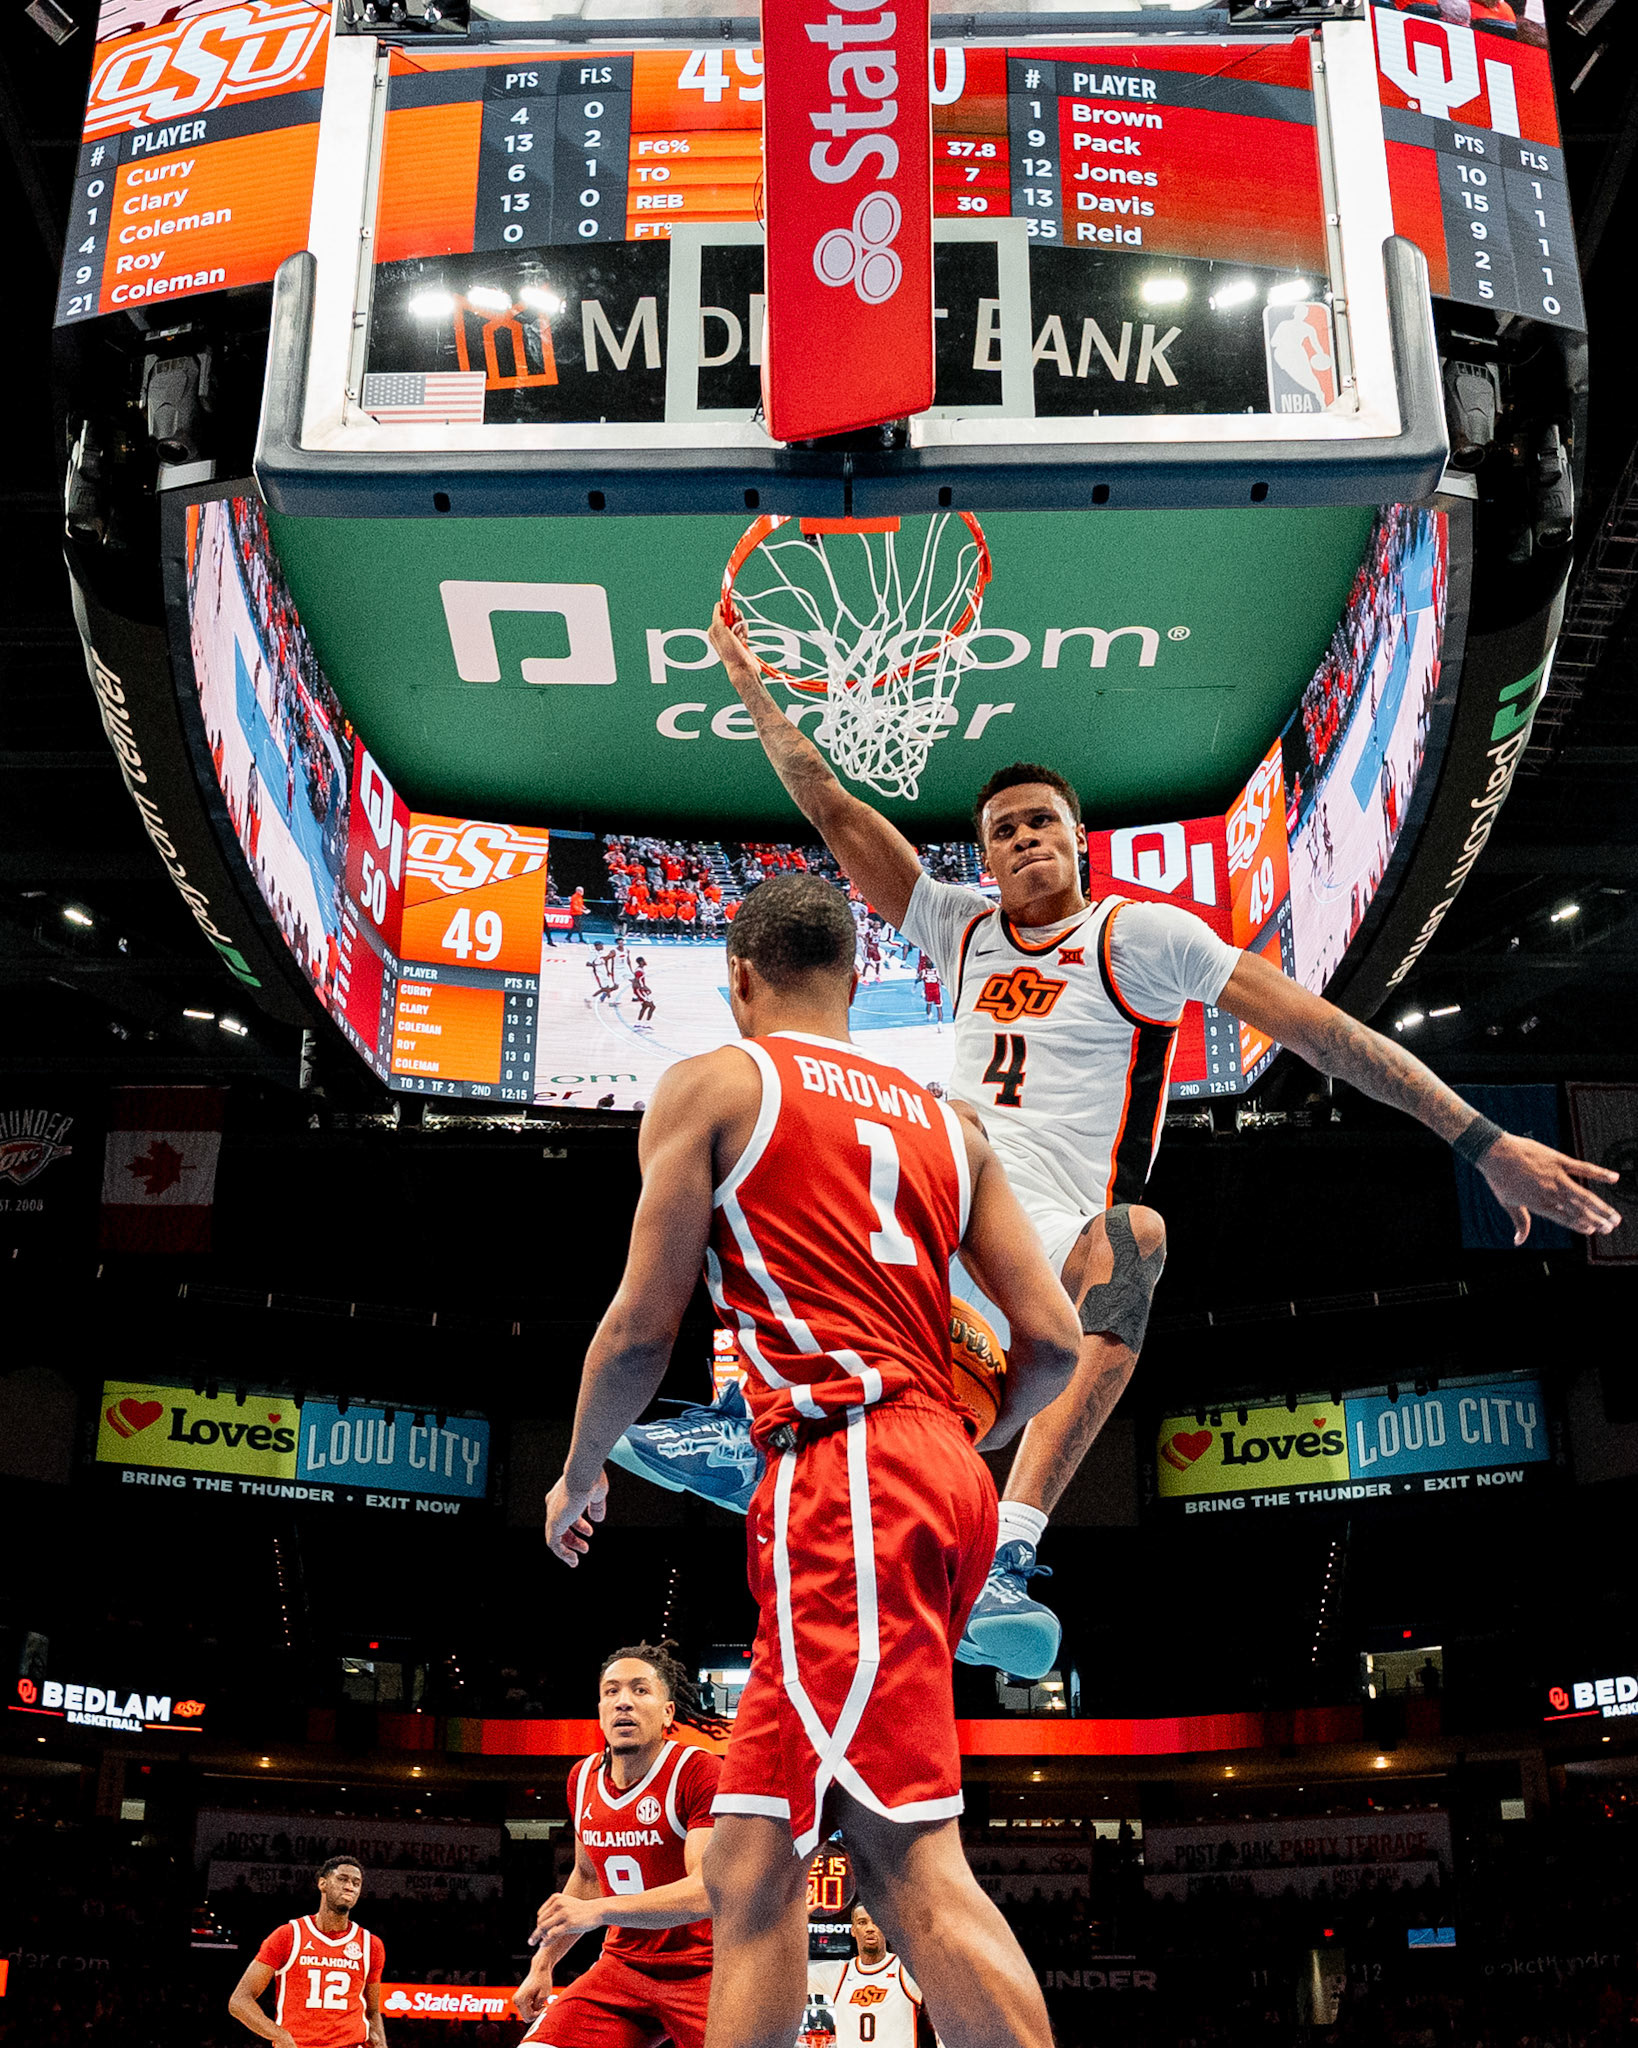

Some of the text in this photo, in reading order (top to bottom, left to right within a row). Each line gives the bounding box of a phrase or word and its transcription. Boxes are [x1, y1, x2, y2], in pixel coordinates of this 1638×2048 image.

[505, 67, 613, 90] PTS FLS
[804, 0, 901, 184] Stat
[1072, 72, 1158, 100] PLAYER
[510, 101, 605, 125] 4 0
[1030, 101, 1163, 130] 1 Brown
[131, 120, 207, 156] PLAYER
[503, 131, 602, 153] 13 2
[638, 140, 690, 155] FG%
[947, 141, 997, 158] 37.8
[1028, 130, 1142, 157] 9 Pack
[1454, 133, 1549, 171] PTS FLS
[87, 159, 196, 197] 0 Curry
[508, 160, 597, 183] 6 1
[636, 167, 671, 182] TO
[965, 167, 980, 182] 7
[1022, 158, 1159, 187] 12 Jones
[1457, 165, 1543, 200] 10 1
[87, 187, 188, 226] 1 Clary
[500, 189, 600, 213] 13 0
[636, 194, 684, 210] REB
[957, 197, 988, 213] 30
[1022, 188, 1156, 217] 13 Davis
[1461, 191, 1547, 228] 15 1
[79, 206, 232, 255] 4 Coleman
[503, 219, 600, 244] 0 0
[1026, 218, 1143, 246] 35 Reid
[1471, 222, 1550, 257] 9 1
[76, 248, 166, 285] 9 Roy
[1475, 251, 1554, 286] 2 1
[66, 266, 226, 317] 21 Coleman
[1478, 281, 1561, 315] 5 0
[1280, 393, 1314, 413] NBA
[90, 646, 233, 943] paycom center
[1386, 728, 1527, 987] paycom center
[360, 850, 387, 925] 50
[1250, 856, 1275, 925] 49
[442, 908, 502, 961] 49
[403, 966, 537, 990] PLAYER PTS FL
[400, 984, 533, 1008] CURRY 4 0
[973, 965, 1068, 1024] OSU
[399, 1003, 532, 1026] CLARY 13 2
[1206, 1007, 1219, 1018] 15
[398, 1021, 531, 1044] COLEMAN 6 1
[1210, 1026, 1217, 1037] 9
[396, 1039, 531, 1063] ROY 13 0
[1211, 1045, 1218, 1055] 2
[395, 1058, 440, 1073] COLEMAN
[506, 1070, 513, 1080] 0
[523, 1071, 530, 1081] 0
[982, 1033, 1028, 1107] 4
[1212, 1063, 1219, 1074] 5
[400, 1077, 413, 1089] TO
[418, 1079, 425, 1090] 3
[432, 1081, 444, 1092] TF
[447, 1083, 455, 1094] 2
[471, 1085, 491, 1097] 2ND
[501, 1088, 528, 1100] 12:15
[793, 1055, 931, 1130] BROWN
[1180, 1081, 1236, 1096] 2ND 12:15
[854, 1117, 919, 1266] 1
[1354, 1400, 1447, 1469] LOUD
[1457, 1397, 1537, 1450] CITY
[306, 1418, 397, 1471] LOUD
[408, 1426, 481, 1486] CITY
[121, 1470, 461, 1515] BRING THE THUNDER EXIT NOW
[1185, 1469, 1525, 1515] BRING THE THUNDER EXIT NOW
[42, 1680, 172, 1722] BEDLAM
[1573, 1676, 1638, 1709] BED
[66, 1709, 143, 1733] BASKETBALL
[1602, 1702, 1638, 1718] BASK
[638, 1797, 660, 1823] SEC
[582, 1829, 664, 1847] OKLAHOMA
[808, 1923, 852, 1934] TISSOT
[299, 1955, 360, 1971] OKLAHOMA
[305, 1969, 351, 2010] 12
[849, 1985, 888, 2008] OSU
[859, 2013, 876, 2042] 0
